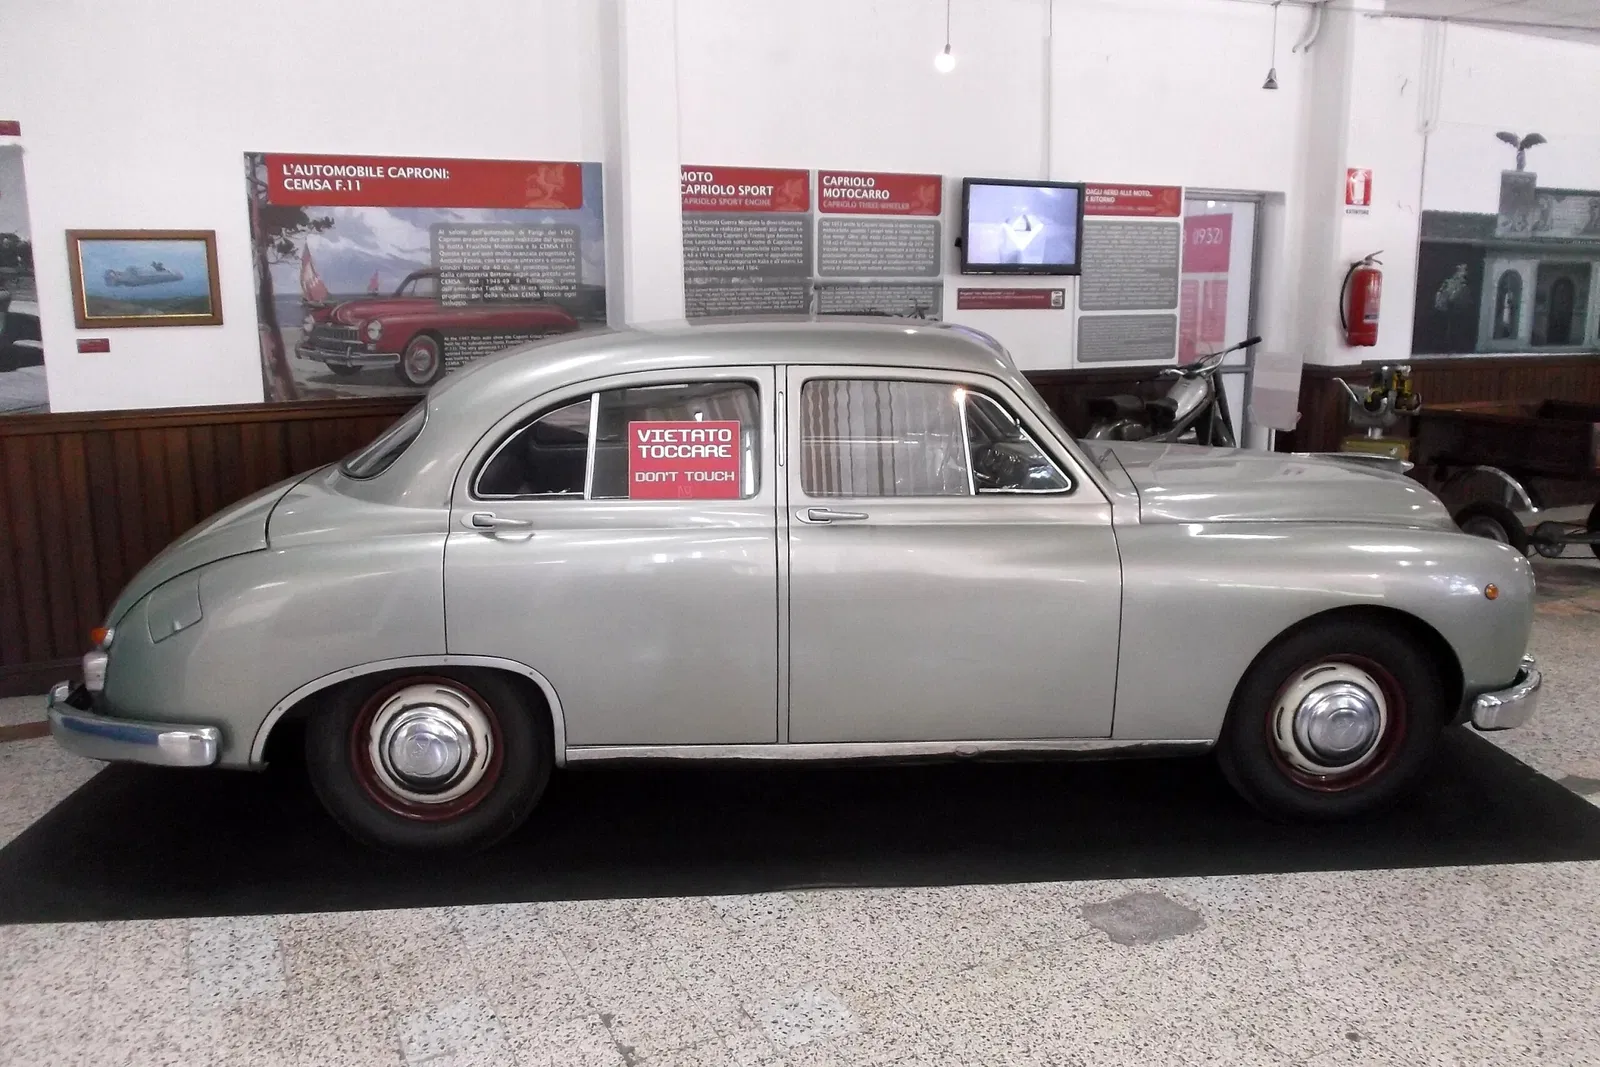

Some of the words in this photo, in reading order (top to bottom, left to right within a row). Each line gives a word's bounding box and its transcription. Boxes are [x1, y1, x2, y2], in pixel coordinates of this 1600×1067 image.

[283, 164, 384, 177] L'AUTOMOBILE
[387, 166, 450, 178] CAPRONI:
[680, 171, 713, 182] MOTO
[284, 178, 331, 190] CEMSA
[335, 179, 361, 191] F.11
[823, 176, 875, 187] CAPRIOLO
[680, 184, 735, 195] CAPRIOLO
[738, 185, 774, 196] SPORT
[823, 188, 890, 200] MOTOCARRO
[637, 428, 732, 442] VIETATO
[637, 444, 732, 458] TOCCARE
[635, 471, 679, 482] DON'T
[684, 471, 735, 482] TOUCH
